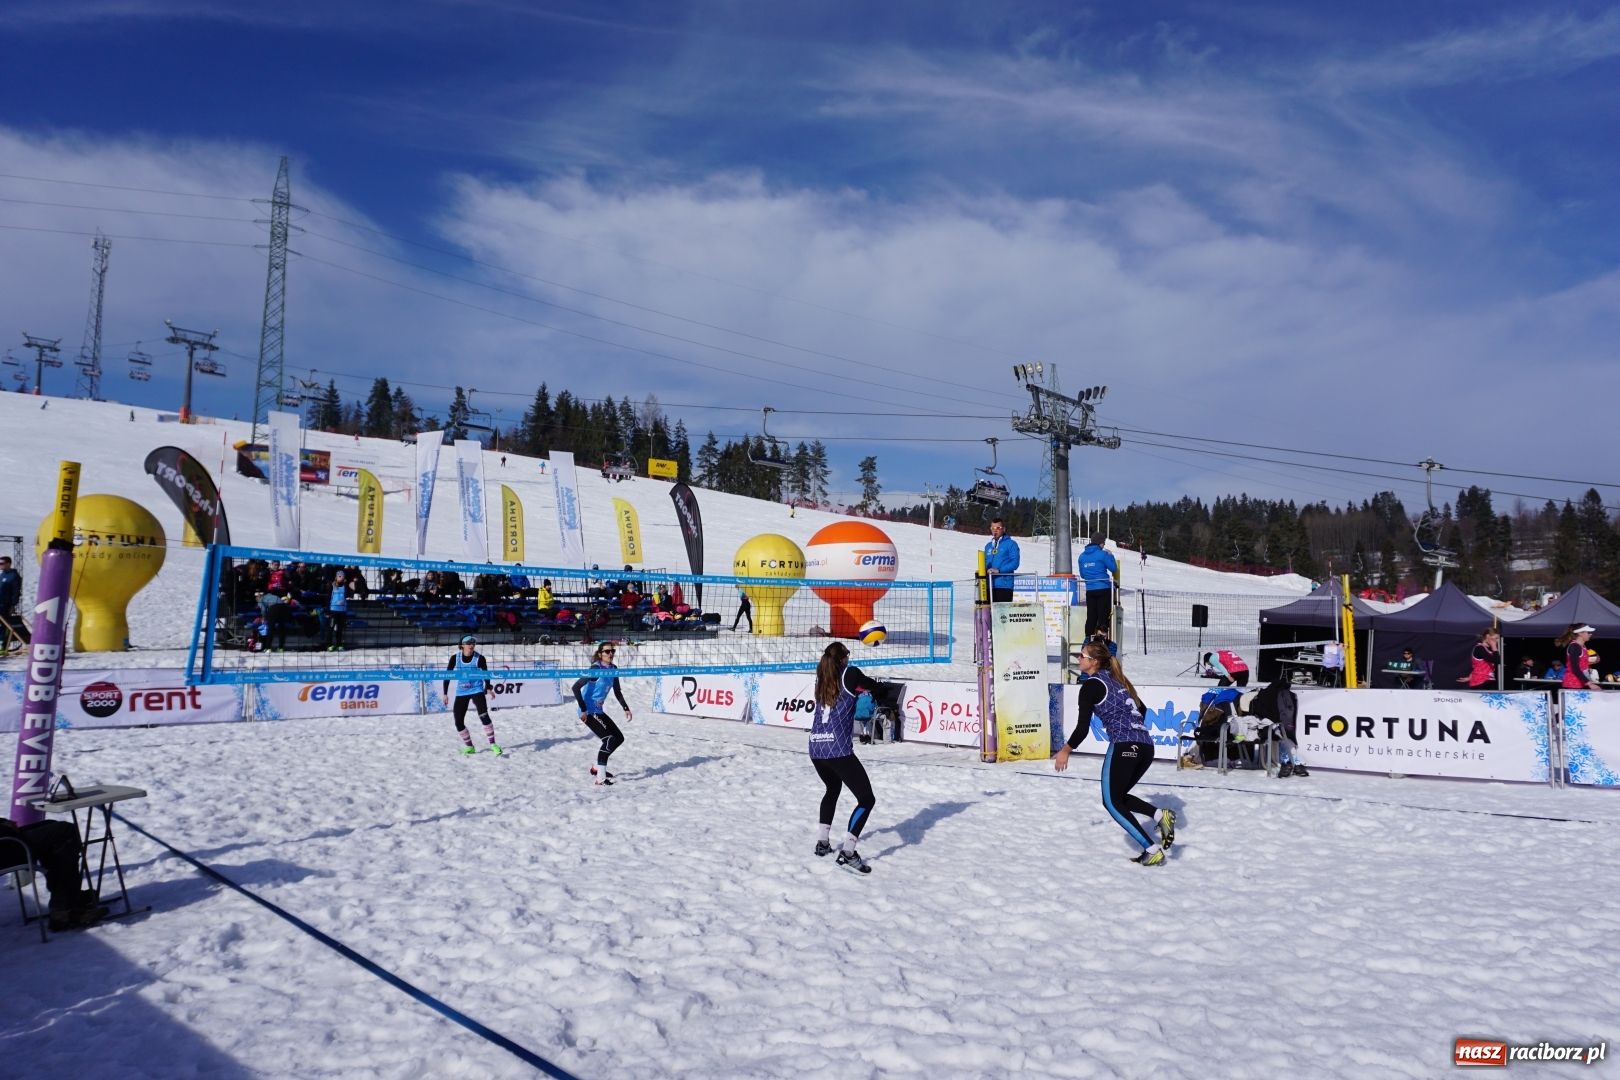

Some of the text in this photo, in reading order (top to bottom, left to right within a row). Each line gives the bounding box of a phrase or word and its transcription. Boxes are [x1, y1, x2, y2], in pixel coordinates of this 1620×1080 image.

[60, 478, 73, 517] SPORT
[73, 534, 157, 548] ORTUNA
[73, 551, 152, 560] akłady online
[805, 558, 828, 567] bania.pl
[853, 550, 896, 566] Terma
[760, 559, 804, 569] FORTUN
[83, 691, 120, 700] SPORT
[129, 685, 202, 712] rent
[298, 681, 380, 702] Terma
[681, 676, 734, 711] RULES
[86, 700, 117, 708] 2000
[776, 697, 815, 713] rhSPO
[940, 703, 980, 718] POLS
[15, 643, 60, 806] BDB EVEN
[939, 717, 980, 734] SIATKÓ
[1304, 714, 1492, 744] FORTUNA
[1306, 742, 1486, 761] zakłady bukmacherskie
